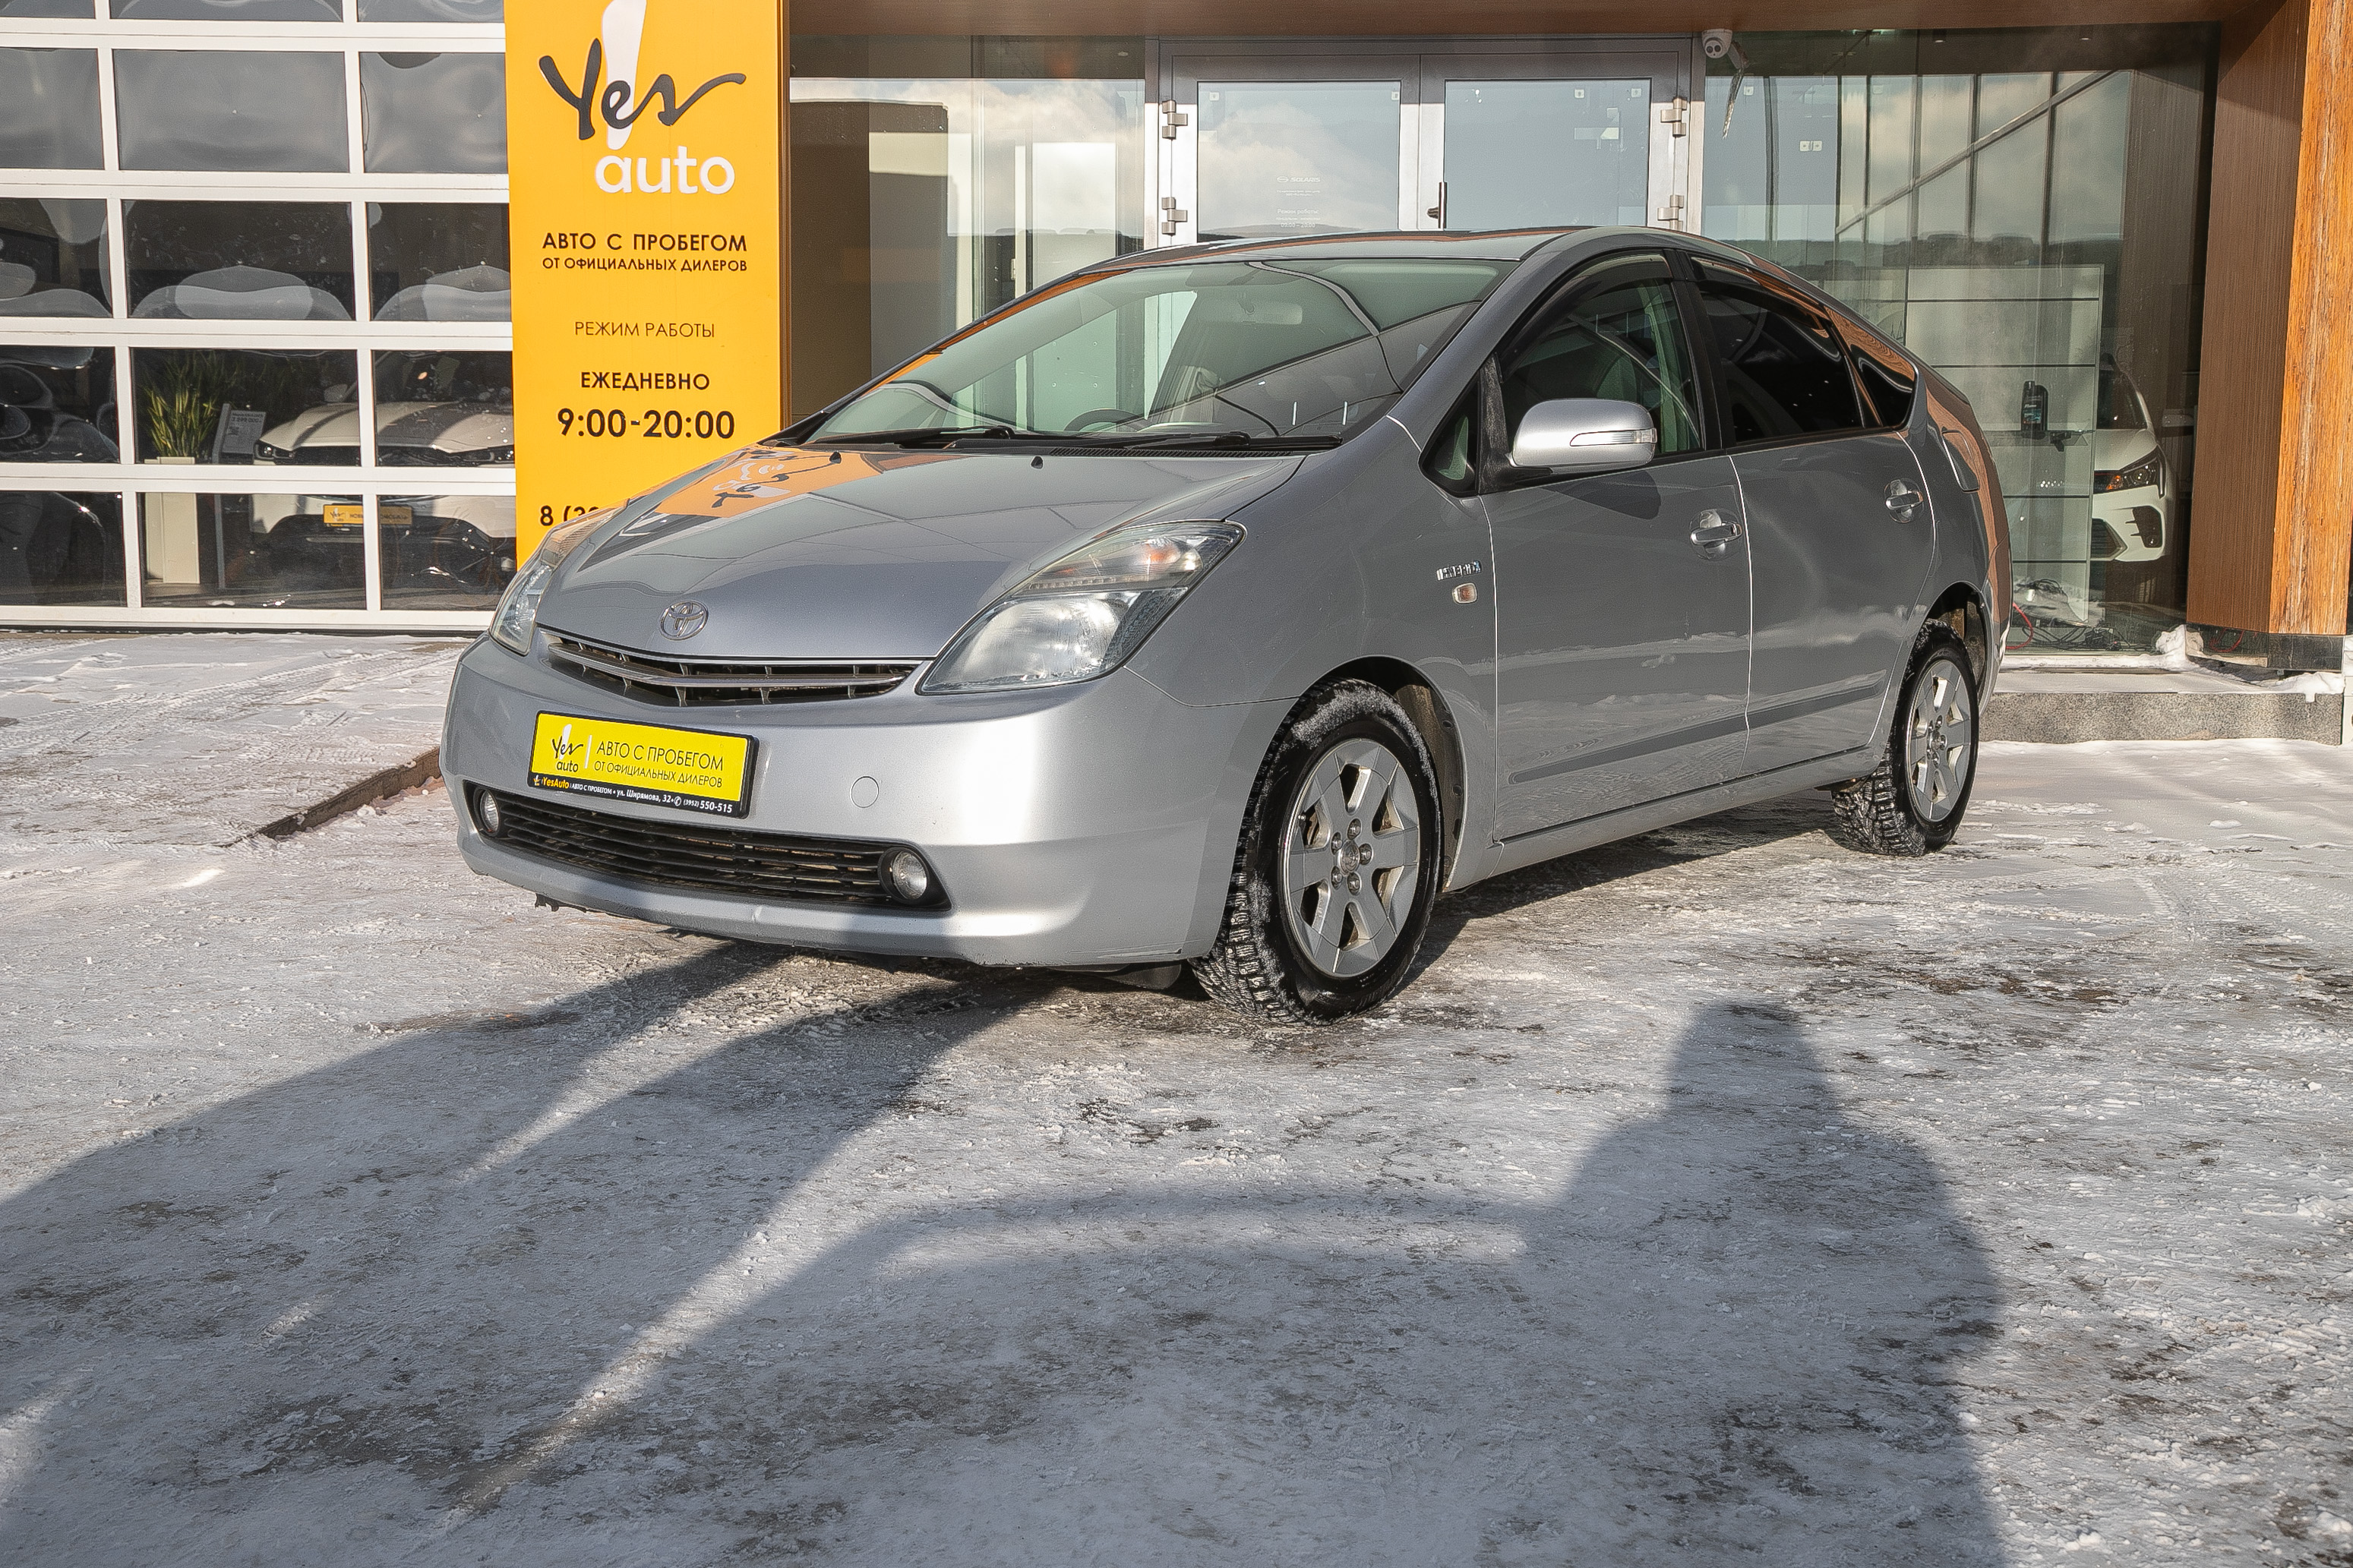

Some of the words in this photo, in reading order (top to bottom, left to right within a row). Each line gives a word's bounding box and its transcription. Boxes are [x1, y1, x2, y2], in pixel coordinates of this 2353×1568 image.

[539, 38, 747, 140] Yes
[595, 145, 735, 194] auto
[542, 232, 596, 250] АВТО
[607, 233, 623, 251] С
[633, 233, 747, 251] ПРОБЕГОМ
[542, 257, 560, 270] ОТ
[564, 257, 677, 271] ОФИЦИАЛЬНЫХ
[681, 259, 747, 272] ДИЛЕРОВ
[575, 321, 640, 336] РЕЖИМ
[646, 322, 715, 338] РАБОТЫ
[581, 371, 710, 391] ЕЖЕДНЕВНО
[557, 408, 734, 439] 9:00-20:00
[540, 505, 554, 526] 8
[552, 735, 583, 759] Yes
[596, 740, 630, 758] АВТО
[633, 745, 644, 761] С
[647, 746, 724, 771] ПРОБЕГОМ
[557, 760, 579, 772] auto
[594, 761, 605, 772] ОТ
[607, 762, 676, 782] ОФИЦИАЛЬНЫХ
[677, 772, 723, 788] ДИЛЕРОВ
[587, 785, 612, 794] ПРОБЕГОМ
[627, 789, 661, 803] Ширямова,
[684, 798, 700, 807] (3952)
[700, 800, 733, 813] 550-515
